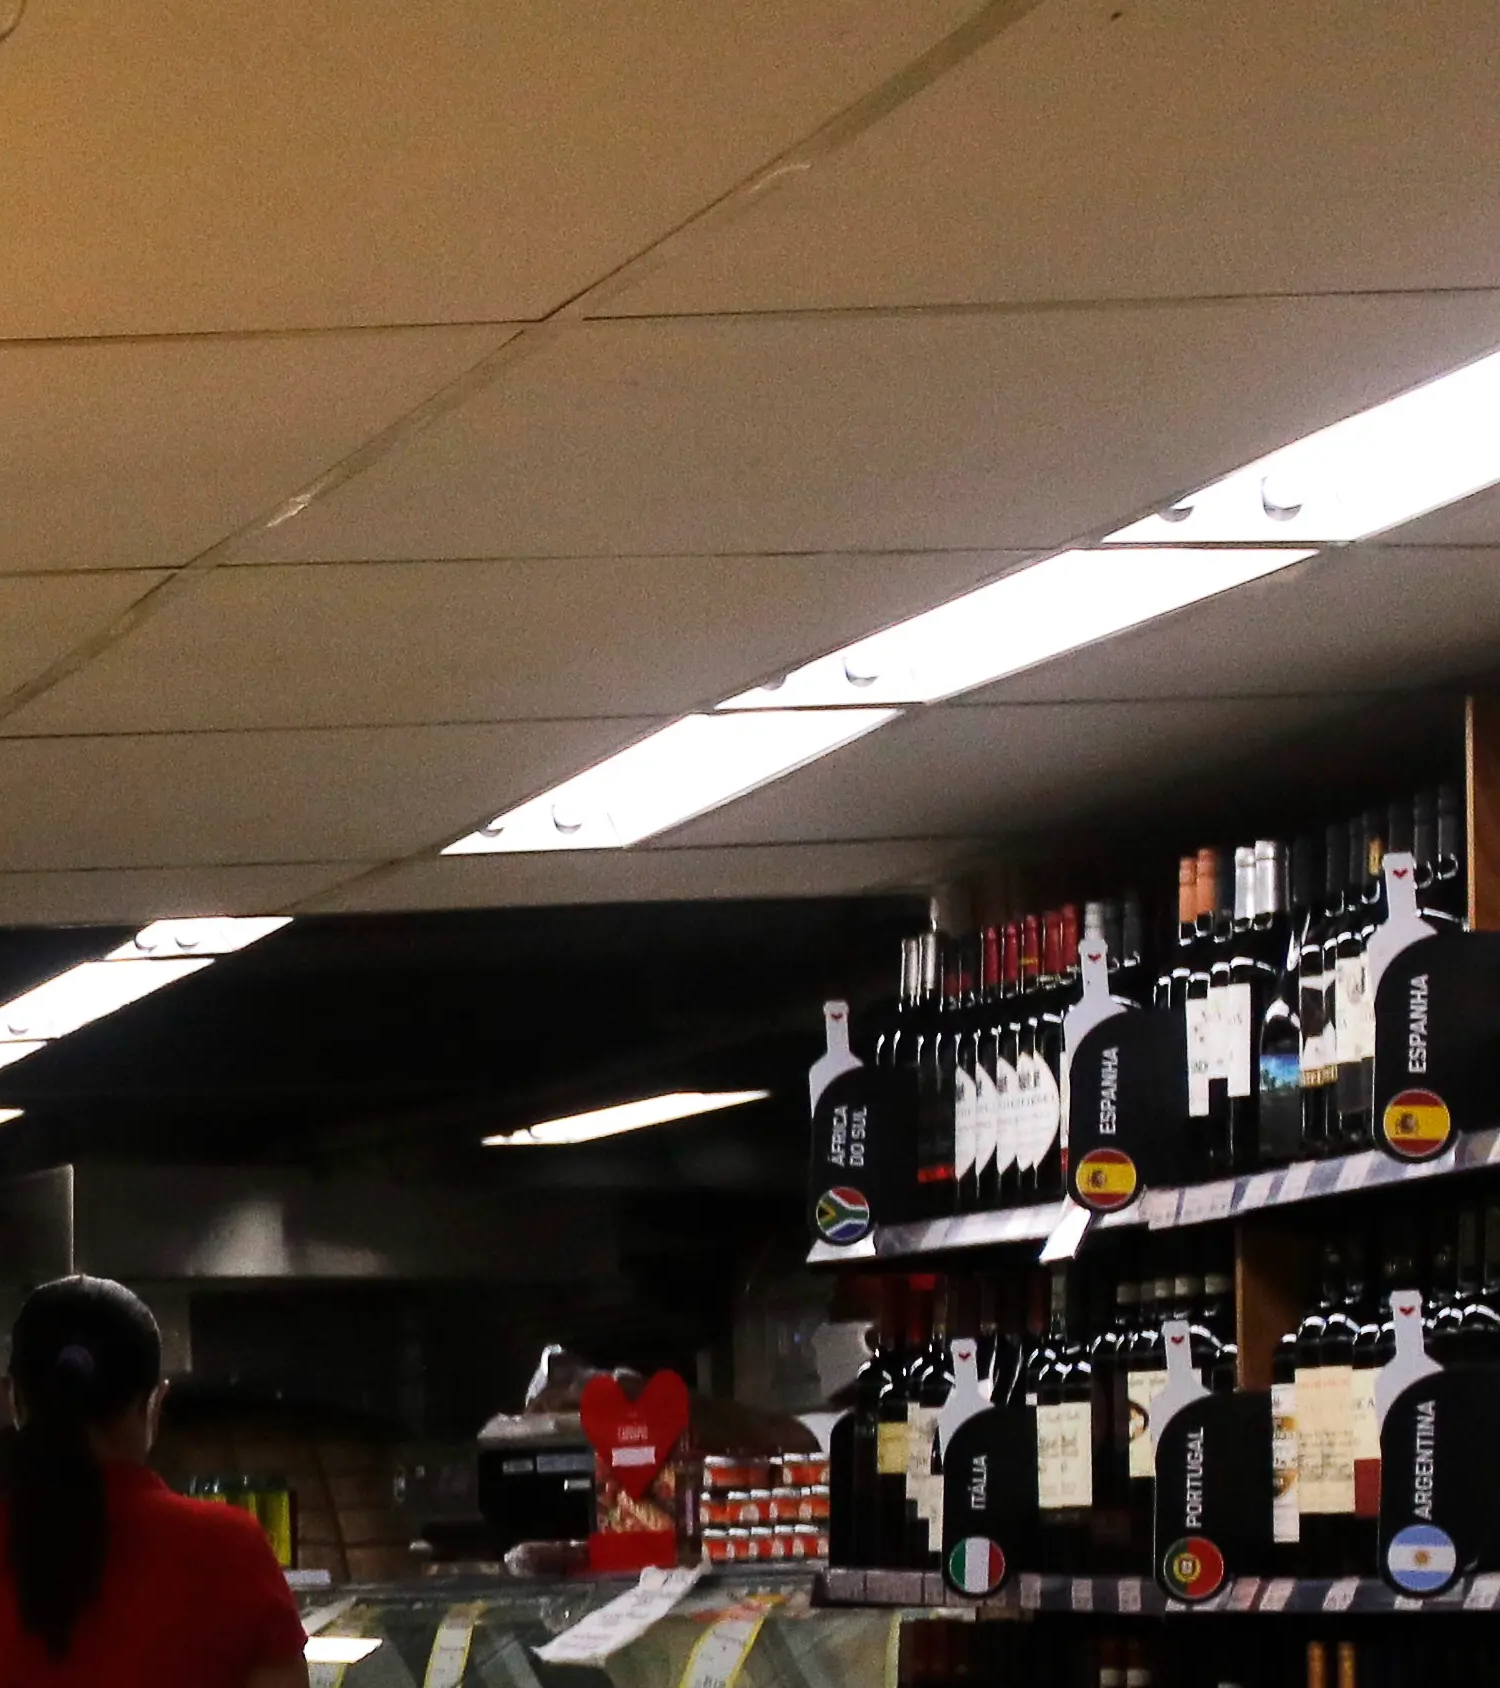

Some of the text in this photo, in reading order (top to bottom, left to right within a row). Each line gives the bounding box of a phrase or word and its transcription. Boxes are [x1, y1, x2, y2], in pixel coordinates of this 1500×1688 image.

[1408, 973, 1429, 1073] ESPANHA
[849, 1104, 867, 1167] DO SUL
[1099, 1046, 1118, 1135] ESPANHA
[1185, 1426, 1204, 1528] PORTUGAL
[1413, 1399, 1436, 1521] ARGENTINA
